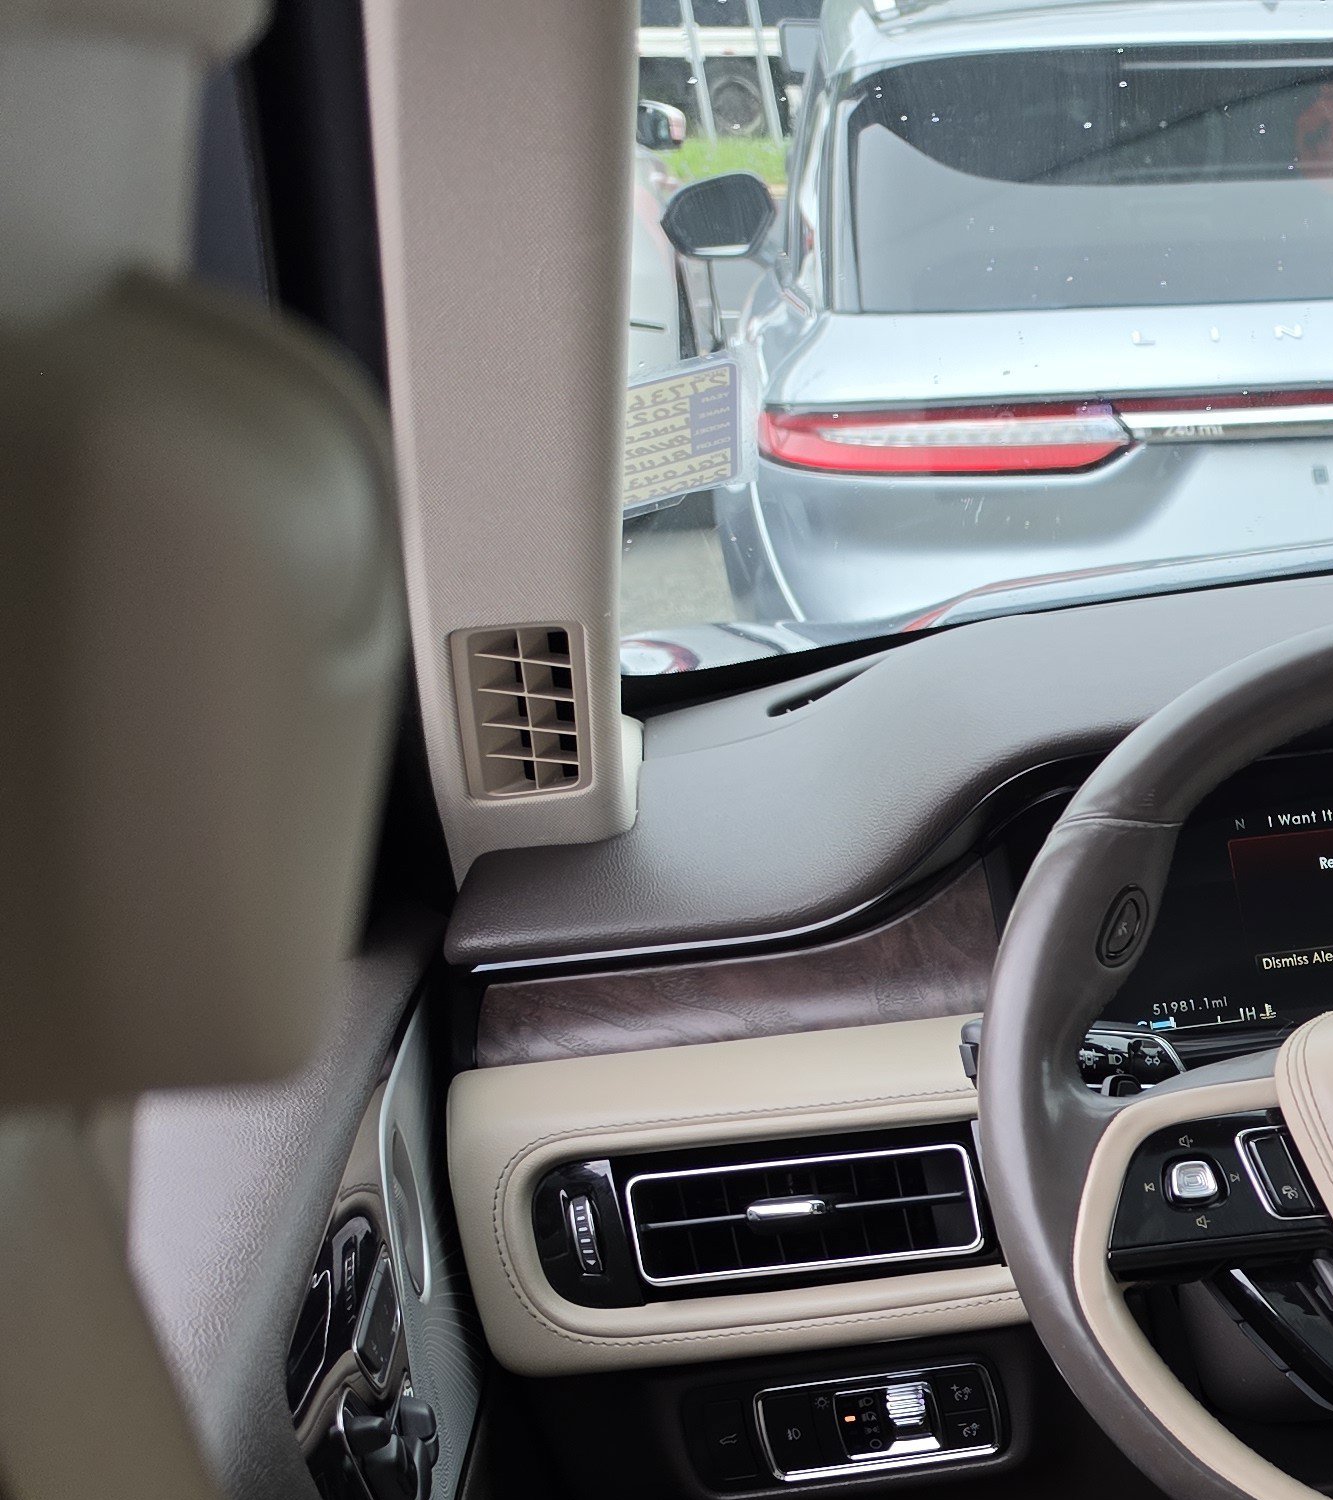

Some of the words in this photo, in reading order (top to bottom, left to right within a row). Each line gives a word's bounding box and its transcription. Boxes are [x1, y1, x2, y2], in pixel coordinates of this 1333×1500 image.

[1235, 818, 1245, 830] N
[1268, 816, 1273, 827] I
[1278, 810, 1317, 826] Want
[1321, 809, 1333, 822] It
[1262, 953, 1309, 970] Dismiss
[1245, 1006, 1257, 1021] H
